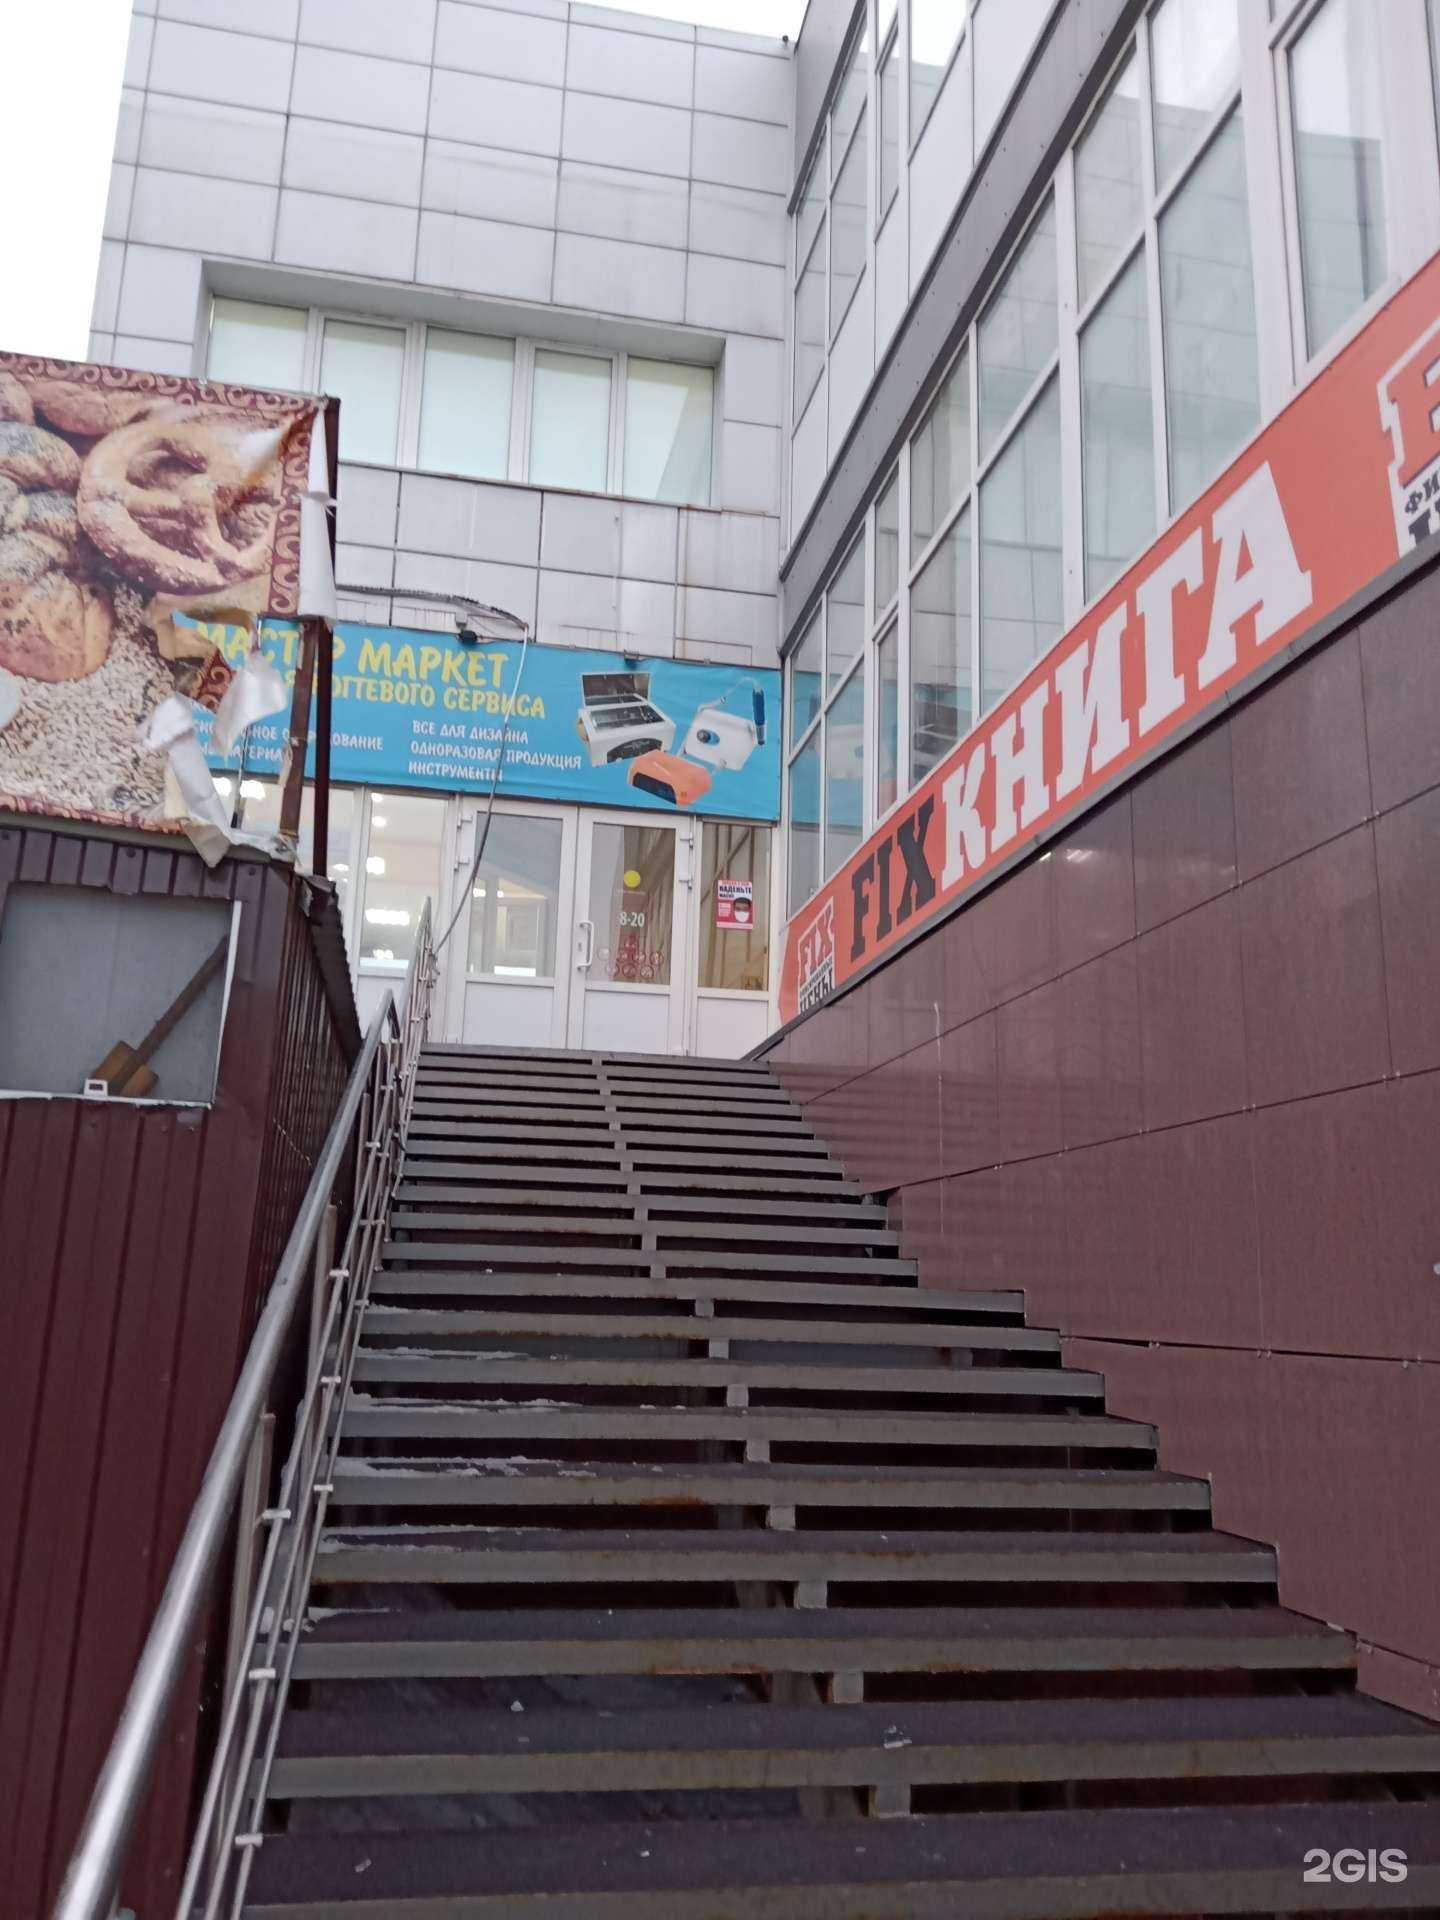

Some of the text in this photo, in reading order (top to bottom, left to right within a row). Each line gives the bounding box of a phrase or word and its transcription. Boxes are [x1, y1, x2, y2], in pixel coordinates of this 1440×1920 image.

[358, 638, 511, 688] МАРКЕТ
[443, 686, 546, 720] СЕРВИСА
[850, 460, 1314, 963] FIX КНИГА
[412, 720, 529, 745] ВСЕ ДЛЯ ДИЗАЙНА
[410, 740, 582, 770] ОДНОРАЗОВАЯ ПРОДУКЦИЯ
[408, 761, 503, 782] ИНСТРУМЕНТЫ
